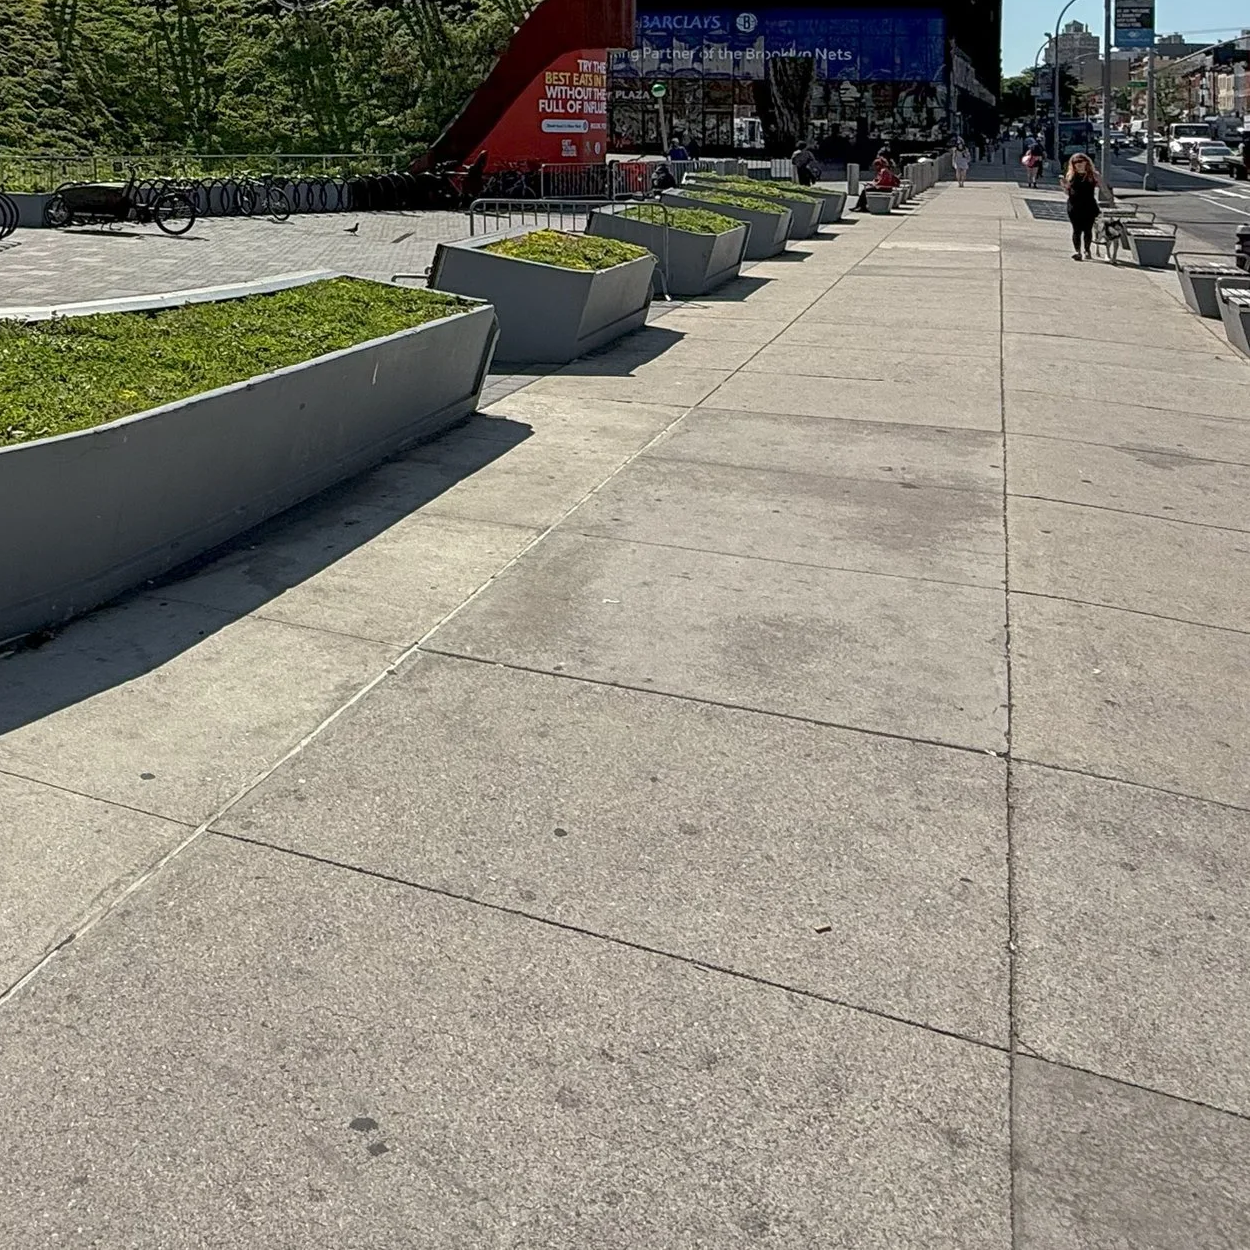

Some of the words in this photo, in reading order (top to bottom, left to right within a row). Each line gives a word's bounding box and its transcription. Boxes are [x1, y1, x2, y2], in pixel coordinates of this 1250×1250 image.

[639, 15, 721, 29] BARCLAYS
[642, 48, 694, 60] Partner
[700, 47, 716, 60] of
[717, 47, 743, 60] the
[815, 47, 852, 60] Nets
[577, 59, 593, 72] TRY
[545, 72, 571, 85] BEST
[573, 73, 592, 86] EATS
[545, 86, 592, 100] WITHOUT
[615, 90, 650, 100] PLAZA
[538, 99, 565, 113] FULL
[566, 100, 582, 113] OF
